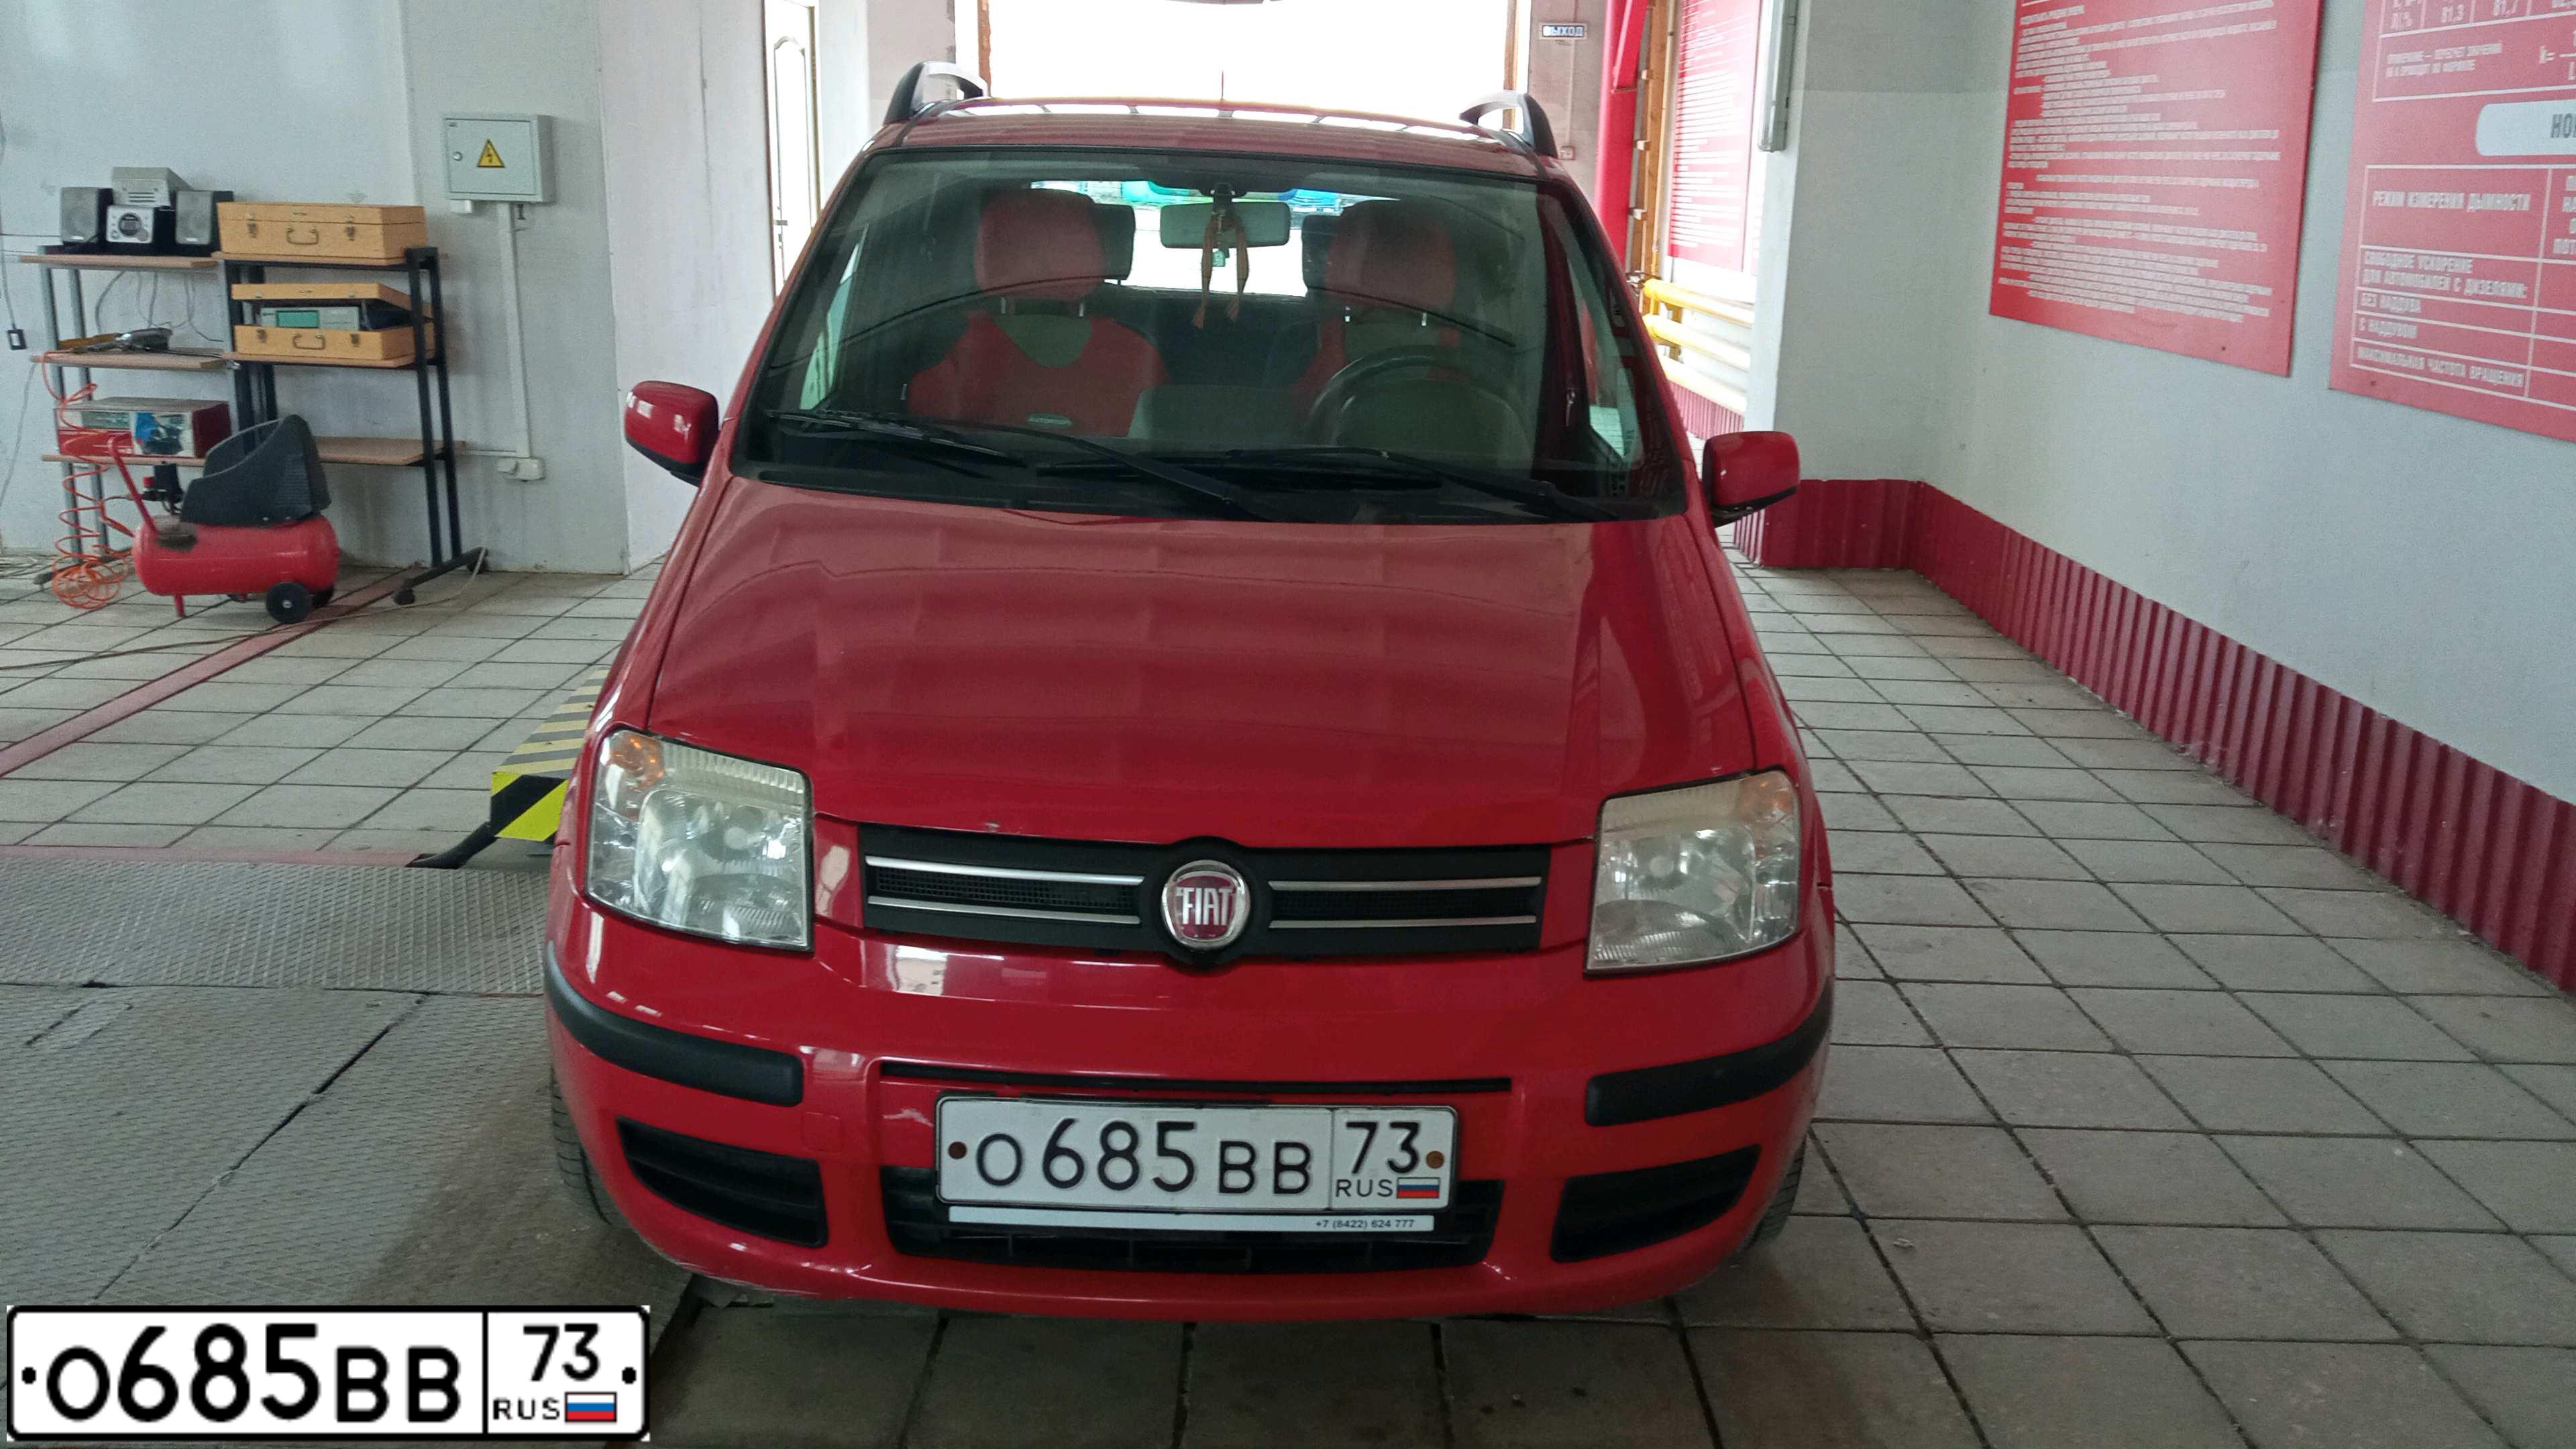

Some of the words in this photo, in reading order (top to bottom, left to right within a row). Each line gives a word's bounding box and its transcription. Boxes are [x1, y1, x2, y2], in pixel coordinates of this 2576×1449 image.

[1543, 25, 1584, 36] ЫХОД
[1179, 886, 1234, 926] FIAT
[1344, 1120, 1420, 1174] 73
[1335, 1178, 1393, 1198] RUS
[1371, 1219, 1391, 1228] 624
[1395, 1219, 1414, 1228] 777
